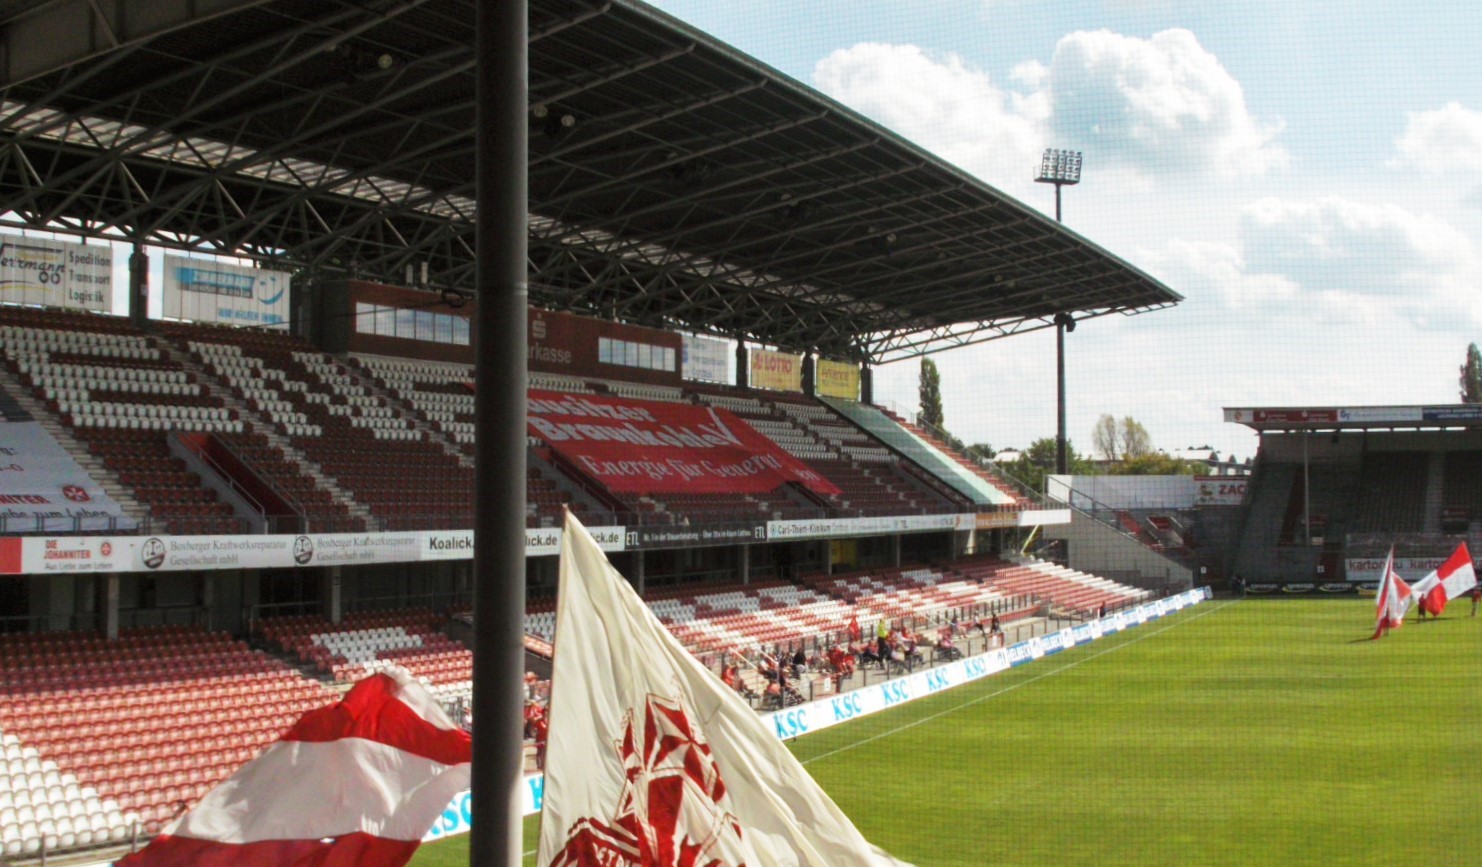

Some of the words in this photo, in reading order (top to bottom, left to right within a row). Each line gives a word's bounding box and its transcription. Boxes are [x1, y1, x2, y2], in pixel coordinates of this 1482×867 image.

[69, 251, 111, 267] Spedition
[69, 288, 105, 304] Logistik
[528, 342, 572, 364] rkasse
[765, 355, 793, 373] LOTTO
[527, 395, 657, 423] ausitzer
[527, 415, 730, 449] Braunkohle
[578, 454, 672, 481] Energie
[664, 458, 702, 482] für
[45, 540, 58, 549] DIE
[170, 540, 210, 553] Boxberger
[213, 539, 287, 552] Kraftwerksreparatur
[429, 536, 475, 550] Koalick.
[525, 534, 558, 548] lick.de
[590, 532, 619, 545] ck.de
[43, 549, 91, 560] JOHANNITER
[170, 555, 217, 566] Gesellschaft
[1409, 558, 1443, 570] karto
[963, 656, 986, 682] KSC
[926, 666, 949, 693] KSC
[880, 679, 909, 705] KSC
[831, 691, 862, 722] KSC
[773, 708, 808, 740] KSC
[431, 792, 472, 835] SC
